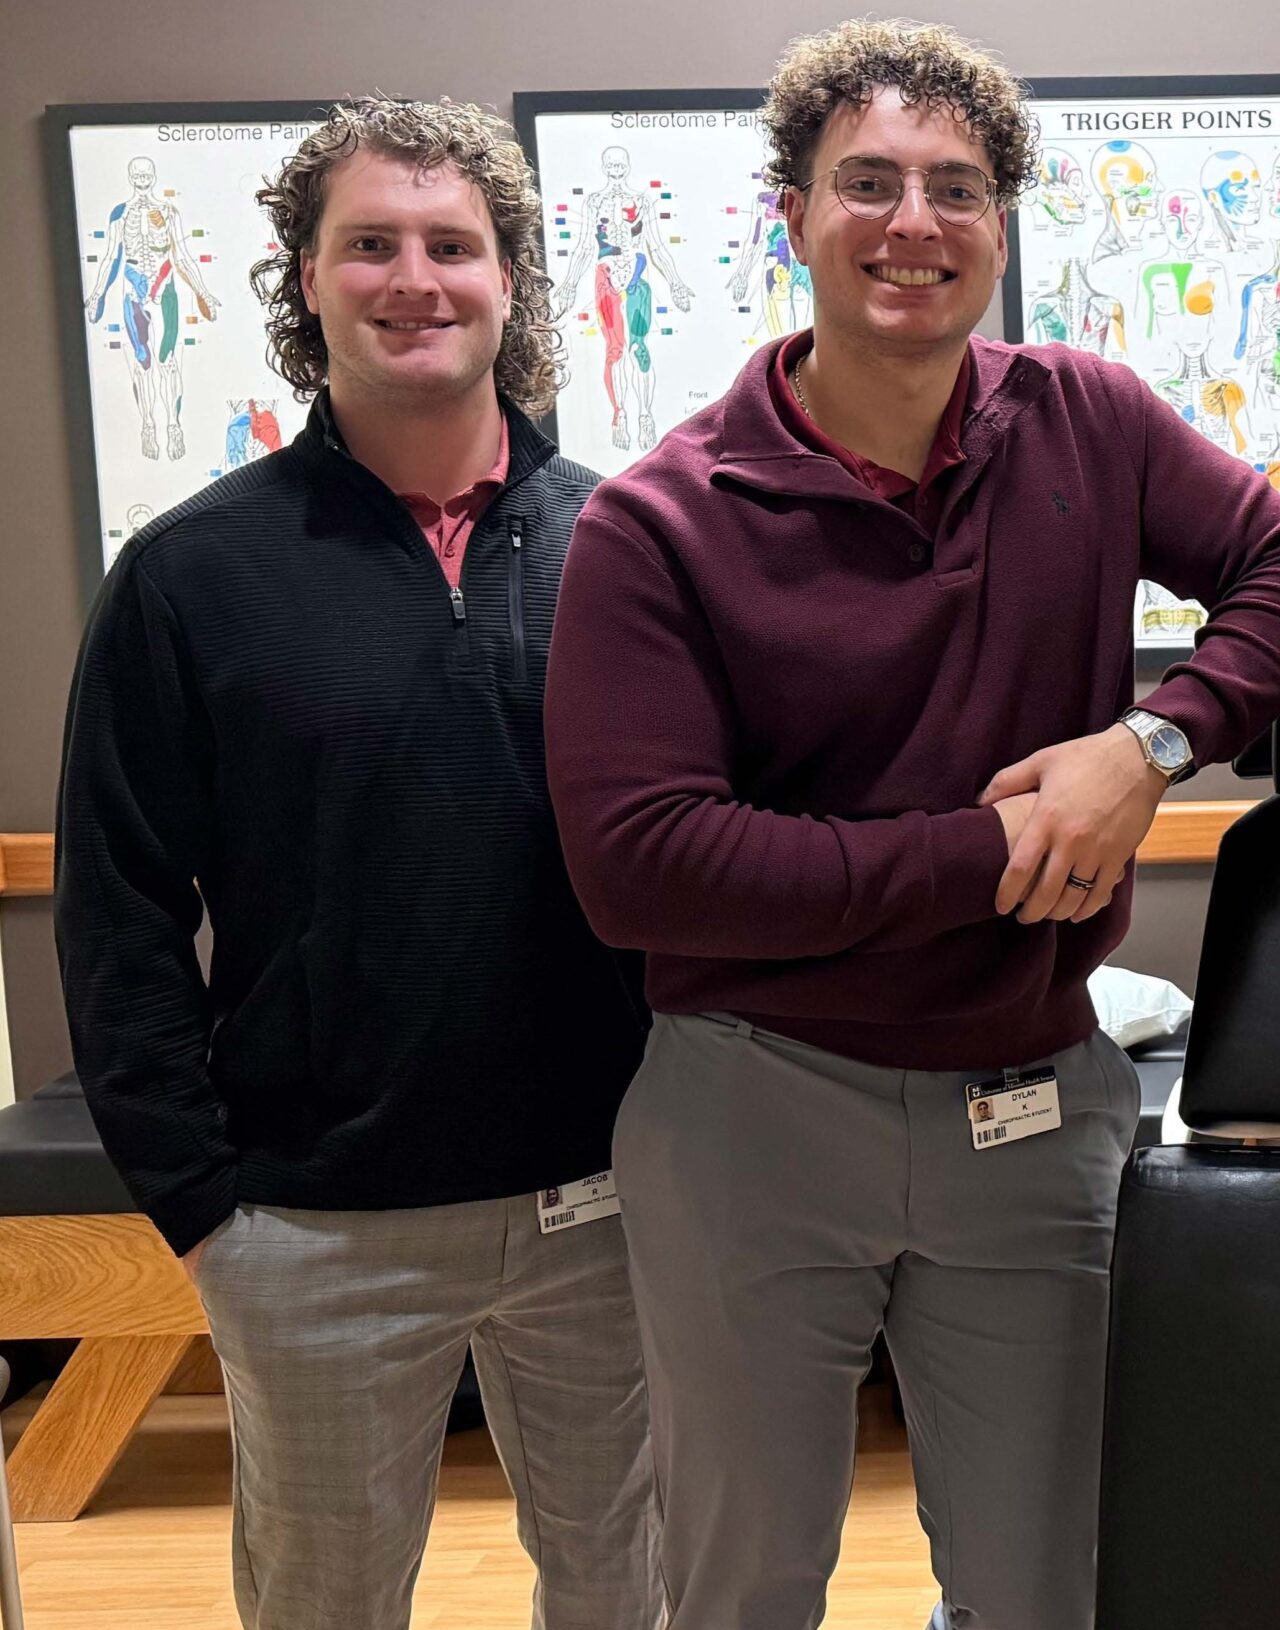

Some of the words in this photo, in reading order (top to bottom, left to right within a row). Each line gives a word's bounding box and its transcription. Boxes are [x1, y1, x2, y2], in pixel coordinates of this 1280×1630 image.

[610, 111, 717, 129] Sclerotome
[1061, 112, 1173, 131] TRIGGER
[1182, 110, 1272, 130] POINTS
[157, 124, 263, 142] Sclerotome
[269, 122, 310, 140] Pain
[1012, 1088, 1037, 1102] DYLAN
[1022, 1103, 1028, 1111] K
[581, 1174, 608, 1187] JACOB
[592, 1188, 598, 1196] R
